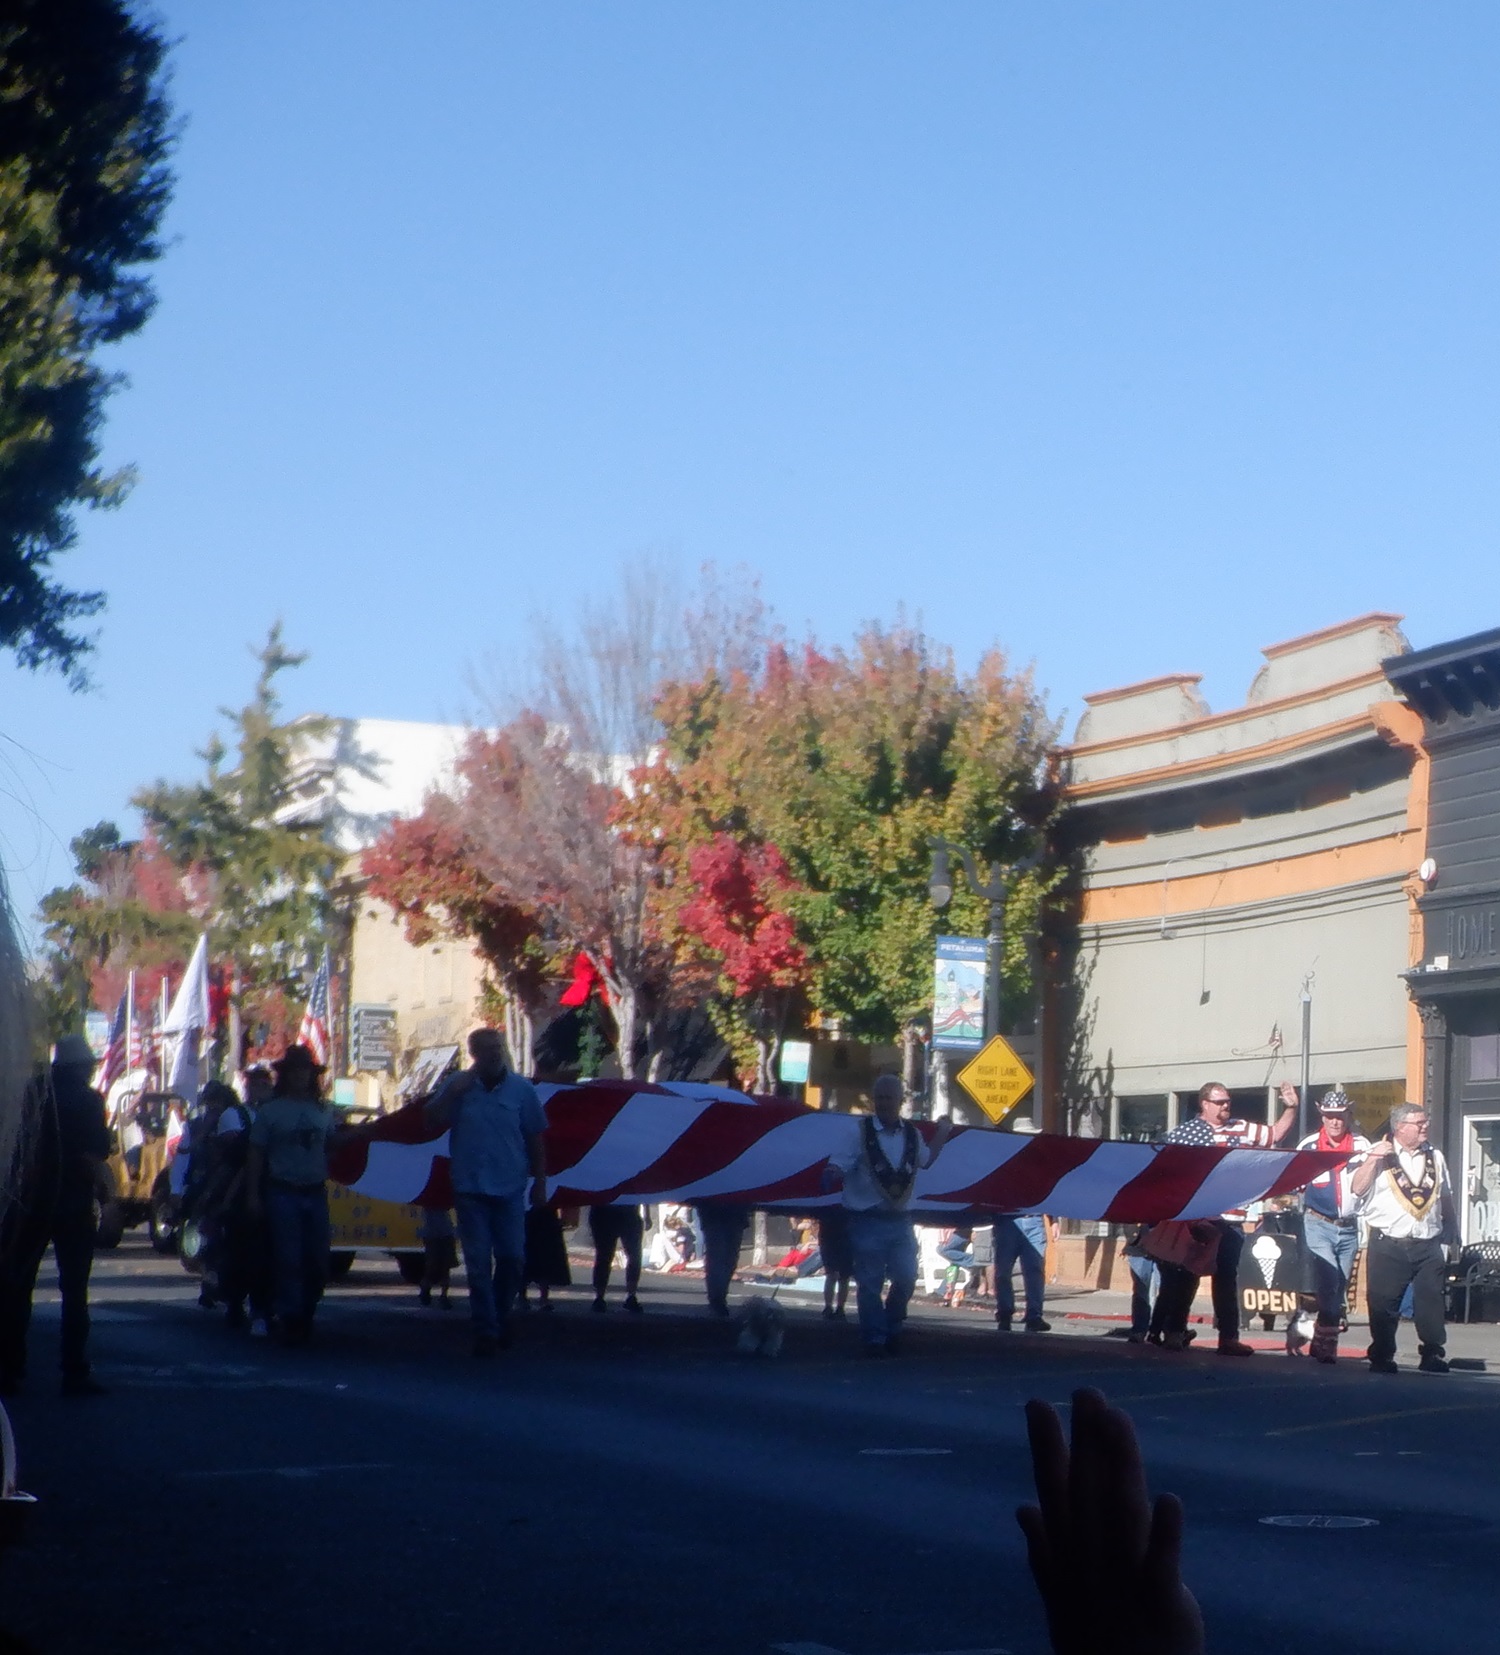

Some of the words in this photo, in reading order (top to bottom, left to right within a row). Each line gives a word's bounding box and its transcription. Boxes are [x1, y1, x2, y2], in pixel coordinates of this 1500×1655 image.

[1446, 910, 1497, 959] HOME
[977, 1064, 998, 1076] RIGHT
[1000, 1067, 1018, 1077] LANE
[975, 1078, 997, 1089] TURNS
[1000, 1080, 1020, 1091] RIGHT
[985, 1094, 1009, 1104] AHEAD
[1243, 1288, 1297, 1312] OPEN
